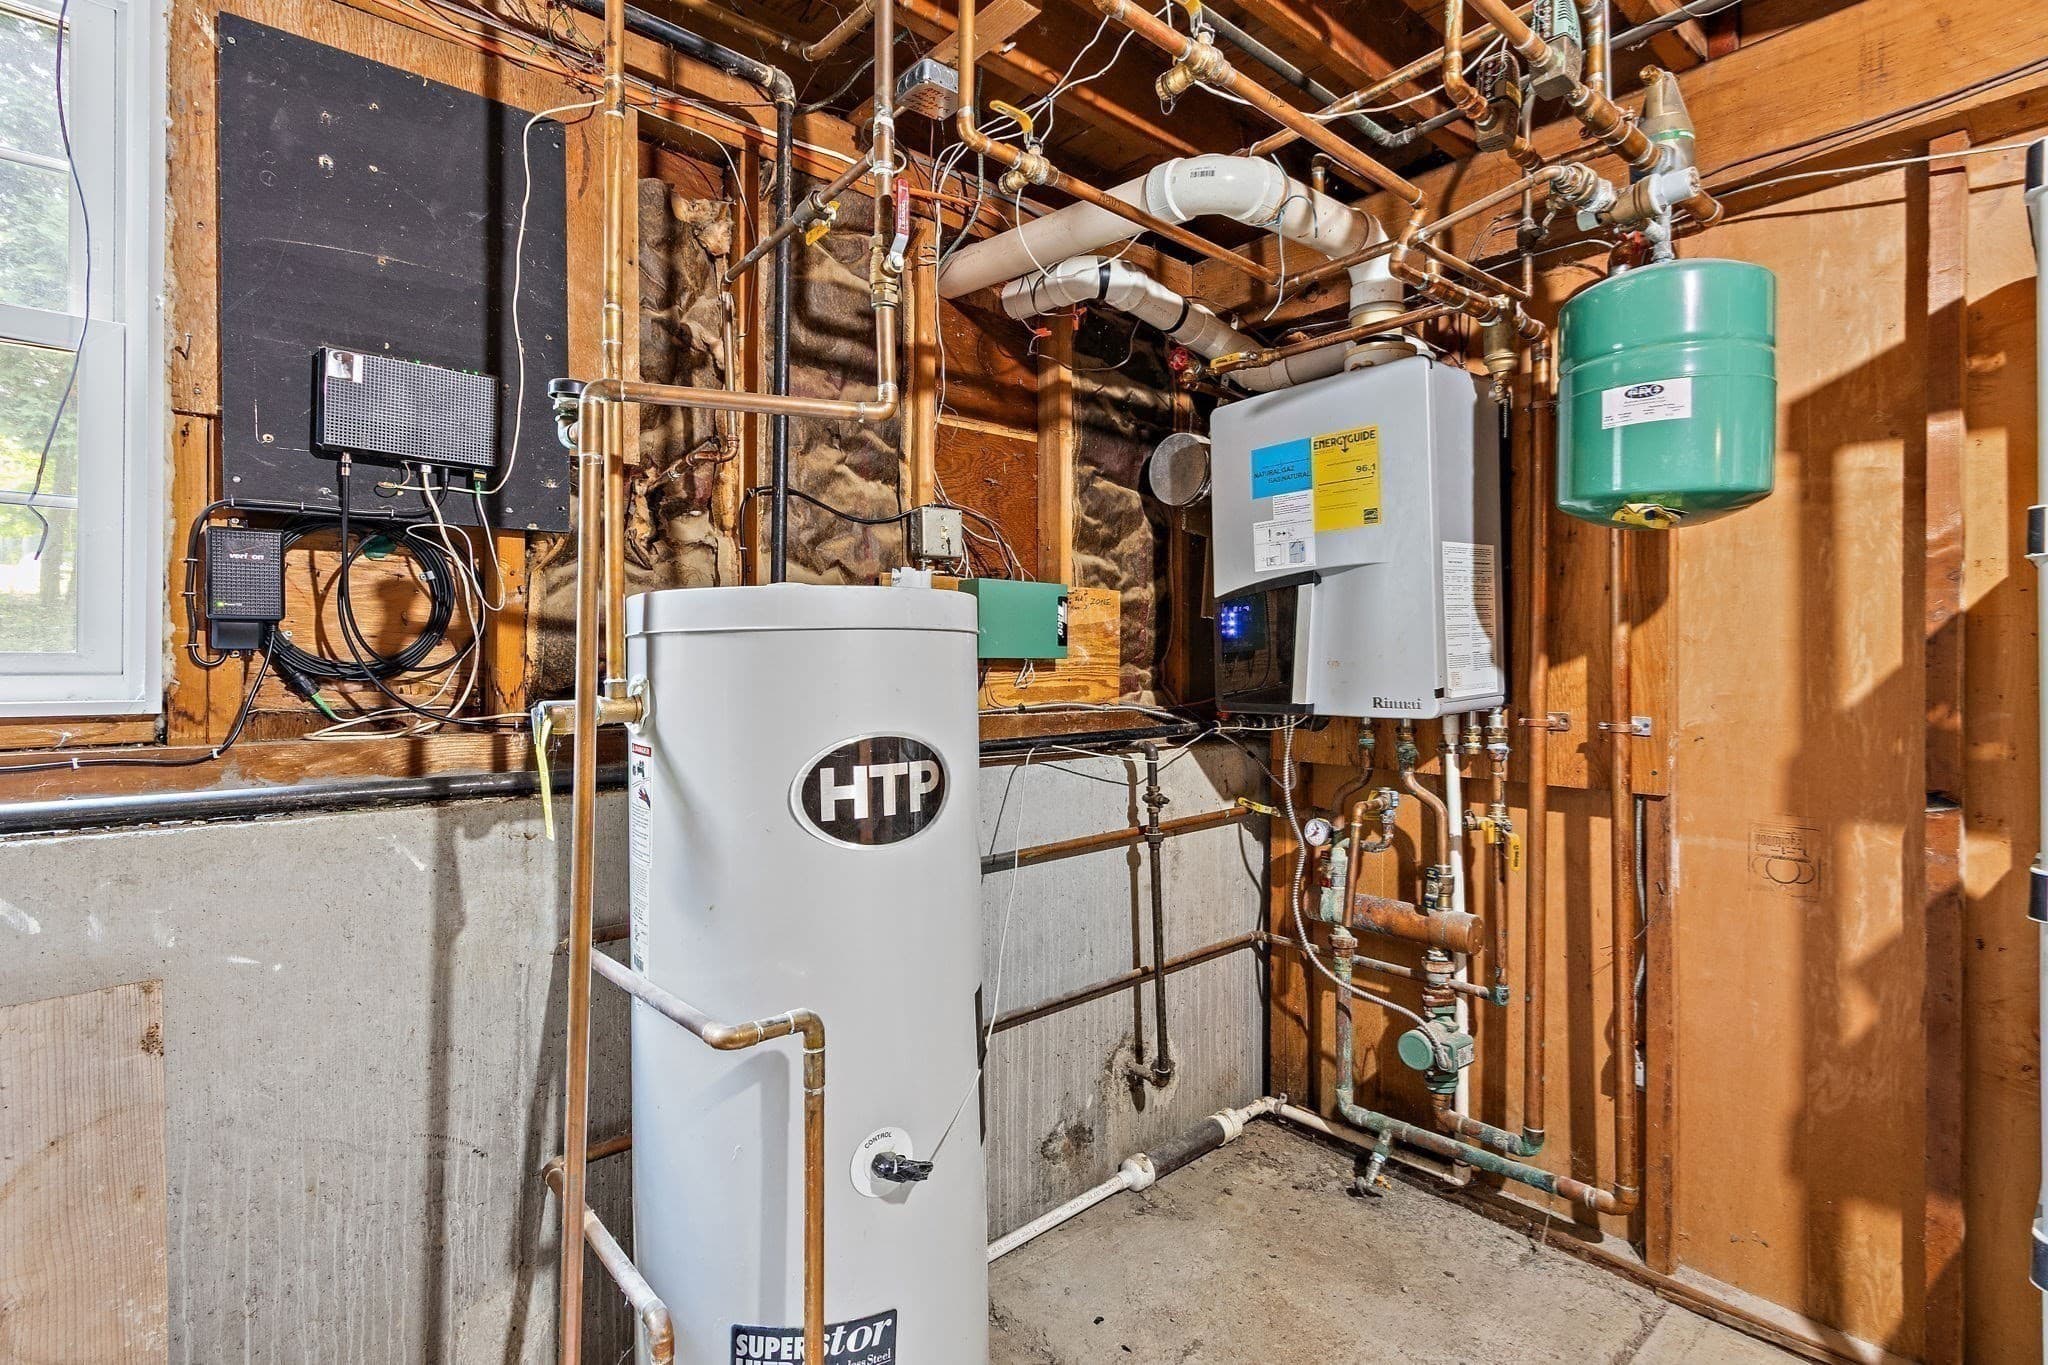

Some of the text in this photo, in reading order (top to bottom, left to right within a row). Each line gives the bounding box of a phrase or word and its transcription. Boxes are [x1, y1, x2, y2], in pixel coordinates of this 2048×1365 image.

[1313, 430, 1376, 451] ENERGYGUIDE
[1356, 463, 1376, 473] 96.1
[1089, 597, 1111, 606] ZONE
[1372, 696, 1422, 710] Rinnai
[819, 759, 940, 822] HTP
[864, 1131, 892, 1149] CONTROL
[867, 1347, 891, 1364] Steel
